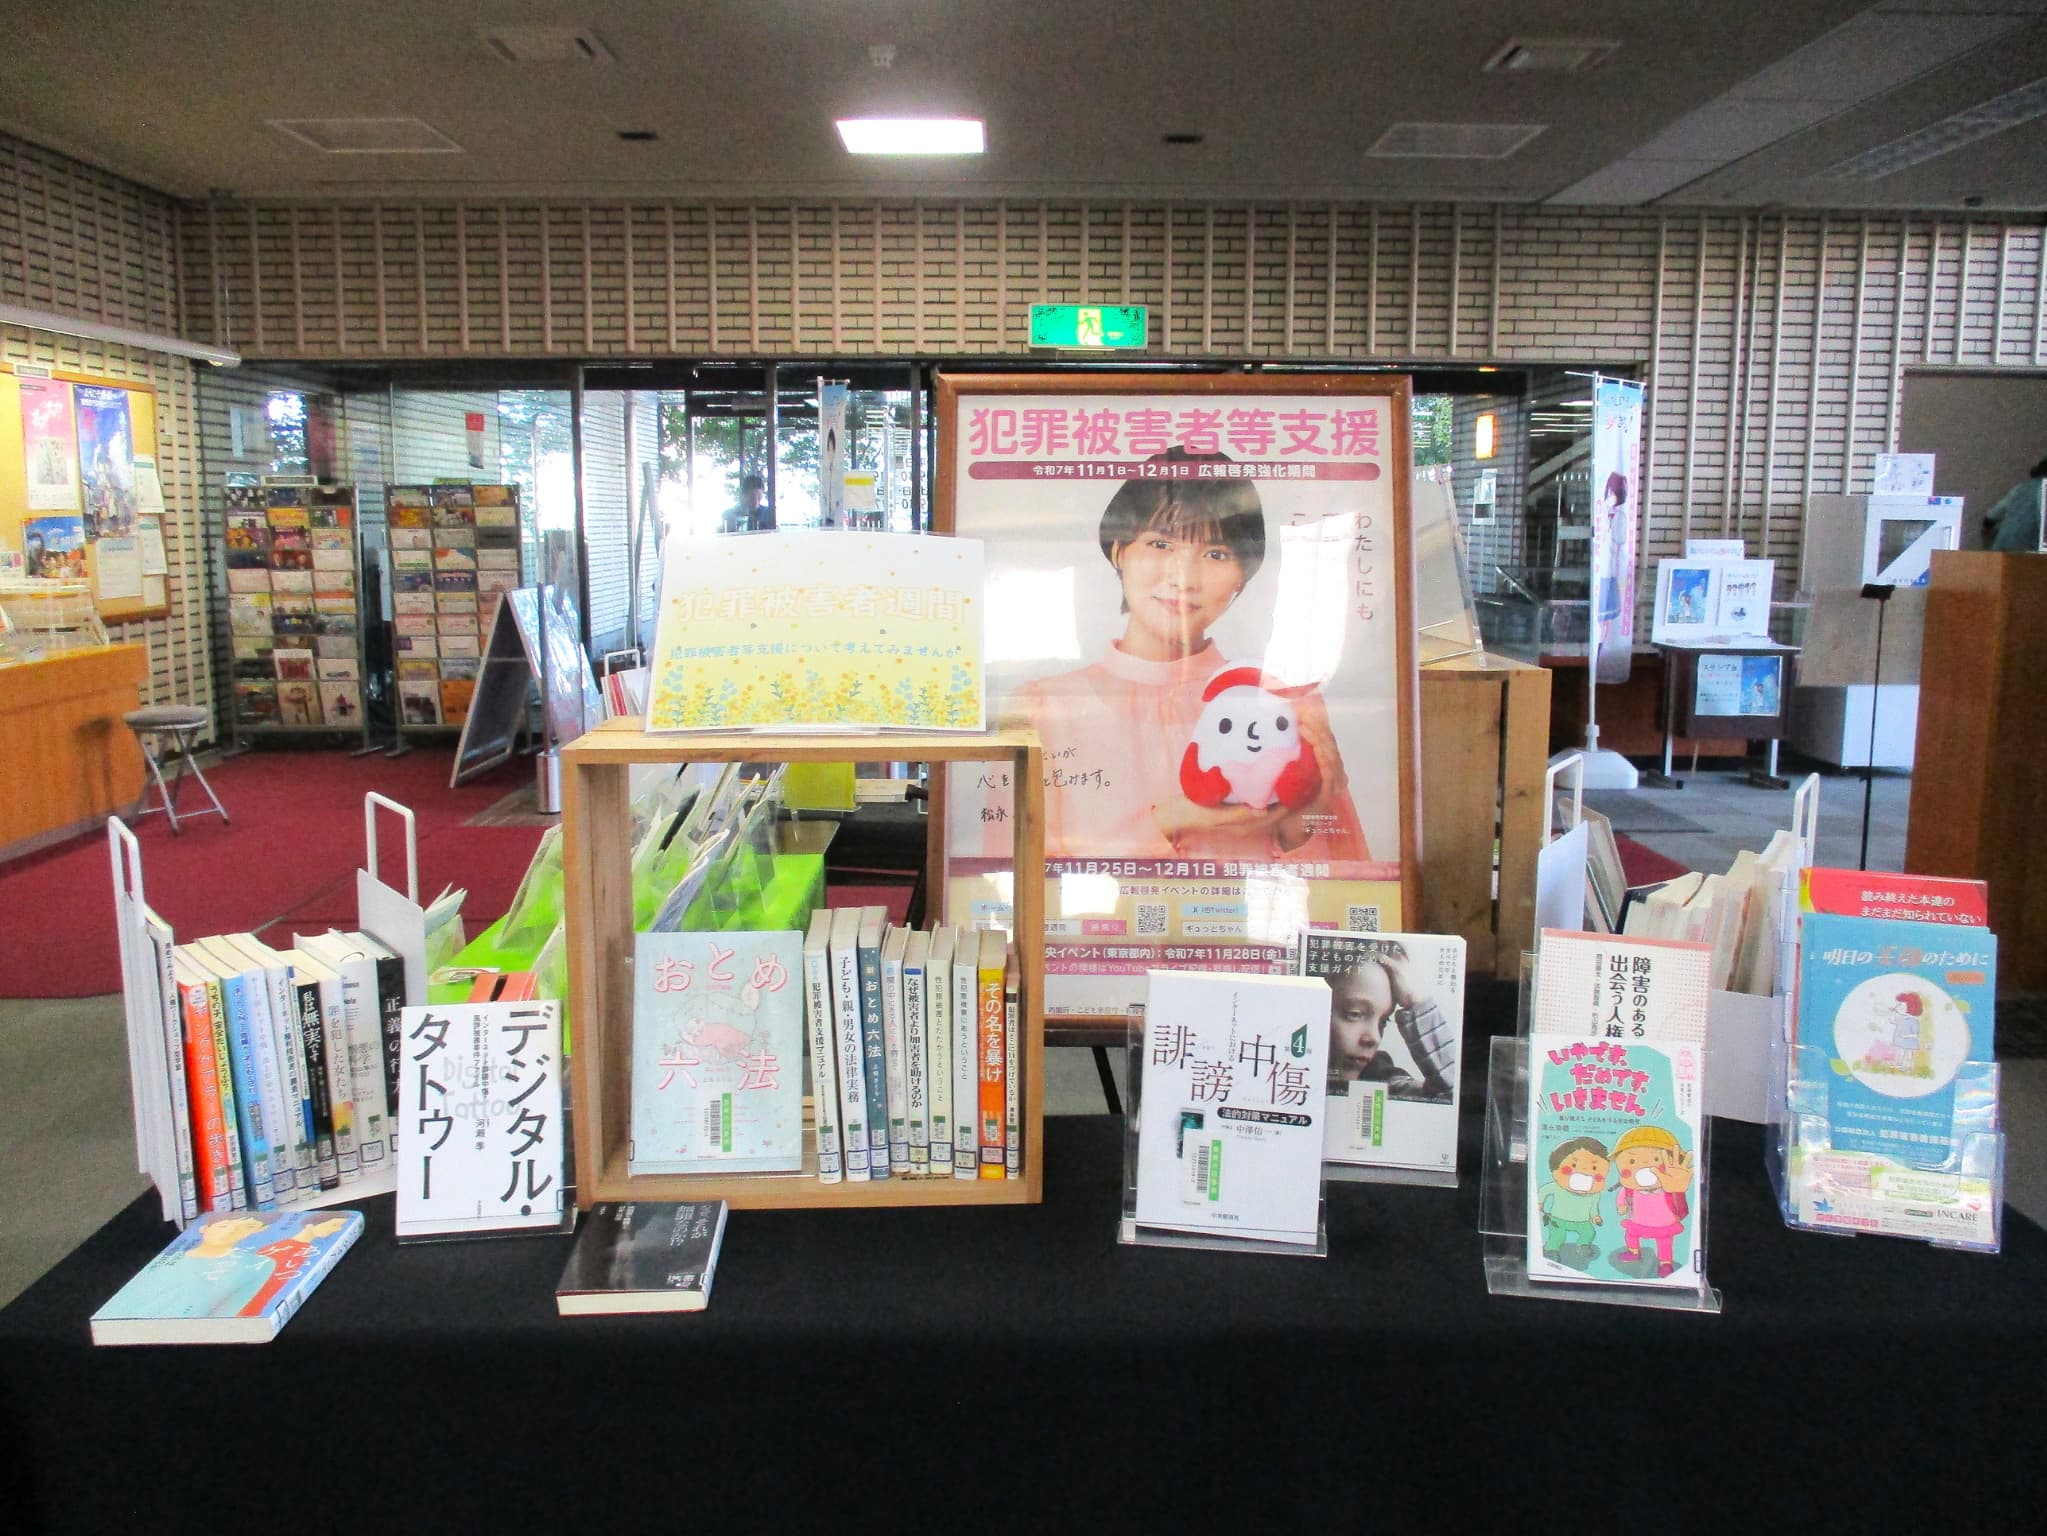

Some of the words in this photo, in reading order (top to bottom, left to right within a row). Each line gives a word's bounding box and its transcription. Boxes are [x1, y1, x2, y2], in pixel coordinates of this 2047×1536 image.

[969, 408, 1380, 456] 犯罪被害者等支援
[1198, 465, 1316, 478] 広報啓発強化期間
[1355, 511, 1374, 621] わたしにも
[676, 584, 966, 624] 犯罪被害者週間
[1309, 938, 1401, 953] 犯罪被害を受けた
[1861, 907, 1982, 924] まだまだ知られていない
[655, 942, 789, 993] おとめ
[1307, 963, 1363, 974] 支援ガイド
[1604, 954, 1629, 1038] 出会う人権
[1631, 956, 1652, 1038] 障害のある
[303, 990, 322, 1062] 私は無実です
[840, 956, 860, 1104] 子ども・親・男女の法律実務
[864, 980, 882, 1058] おとめ六法
[907, 977, 923, 1108] なぜ被害者より加害者を助けるのか
[985, 982, 1003, 1083] その名を暴け
[327, 1004, 347, 1099] 罪を犯した女たち
[657, 1047, 781, 1091] 六法
[1153, 1024, 1311, 1107] 誹謗中傷
[1547, 1041, 1629, 1067] いやです、
[1569, 1063, 1650, 1094] だめです、
[409, 1012, 454, 1200] タトゥー
[1549, 1086, 1647, 1117] いきません。
